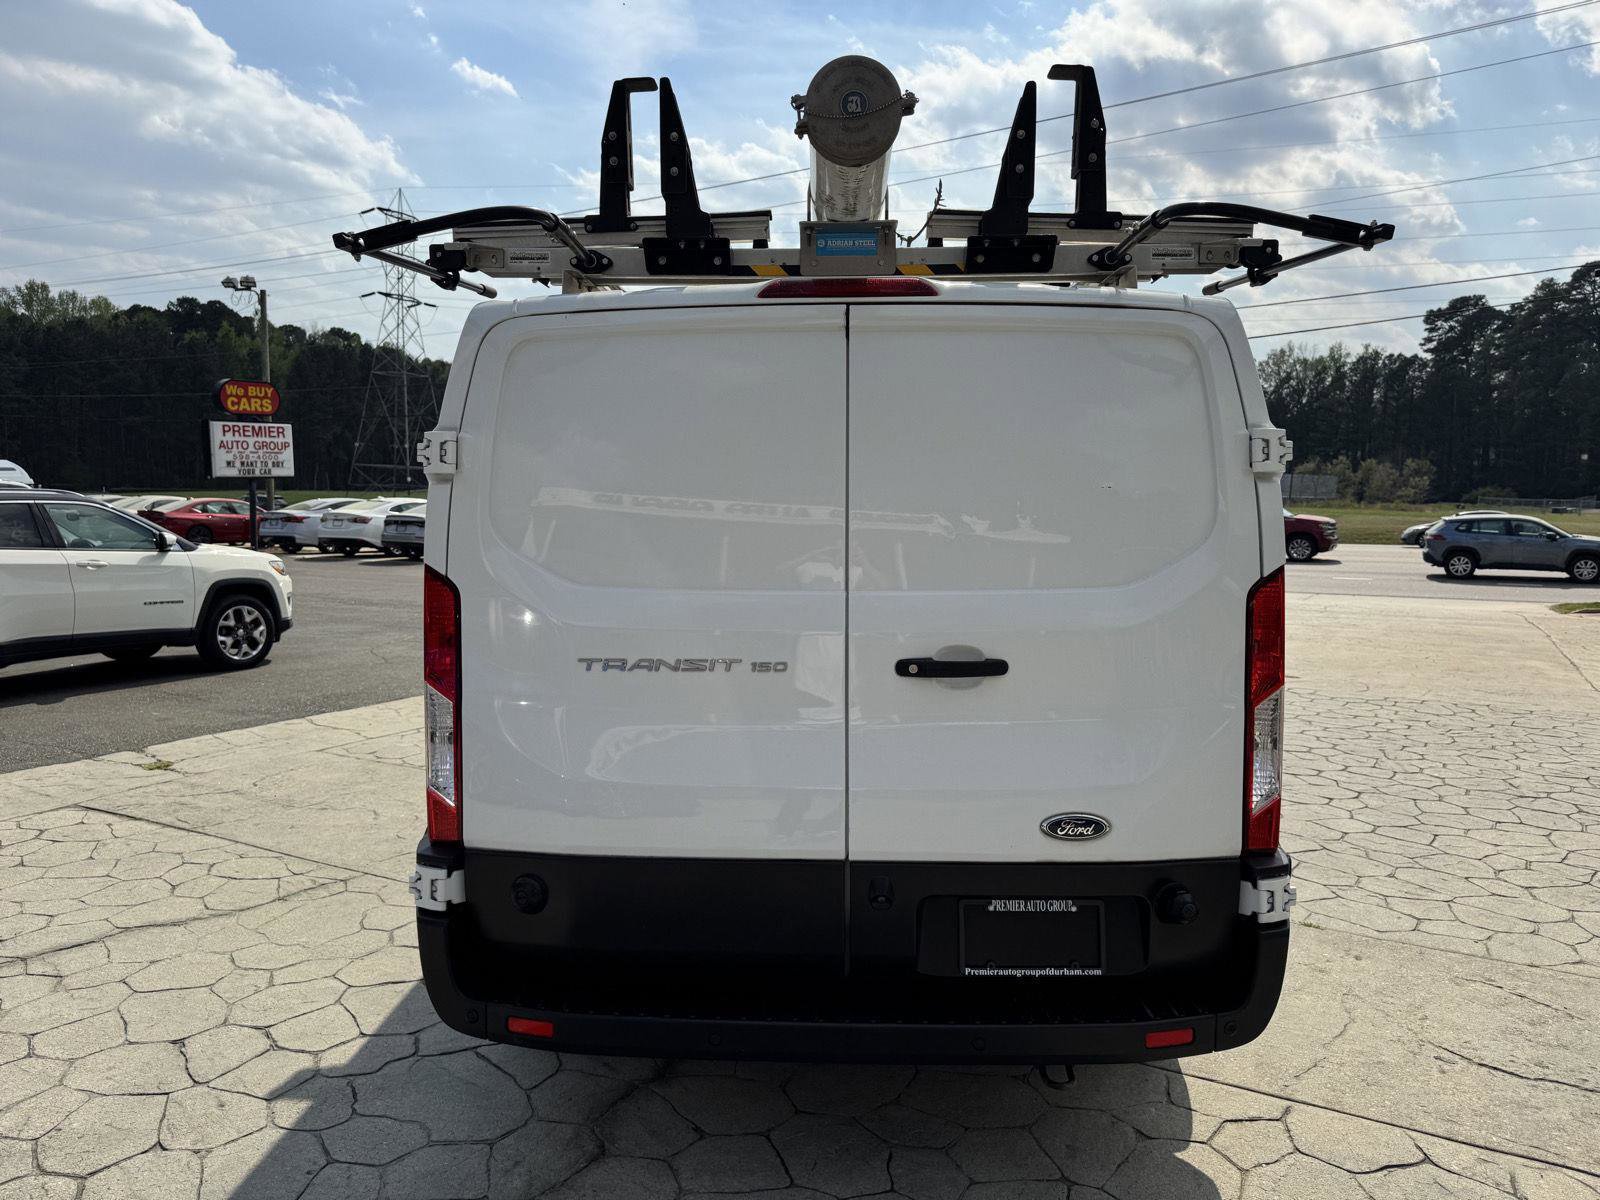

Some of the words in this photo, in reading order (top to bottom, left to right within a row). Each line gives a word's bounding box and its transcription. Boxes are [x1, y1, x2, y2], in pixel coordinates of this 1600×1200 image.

[827, 239, 853, 247] ADRIAN
[854, 239, 876, 247] STEEL
[225, 384, 244, 396] We
[248, 386, 274, 397] BUY
[226, 396, 273, 412] CARS
[222, 424, 286, 438] PREMIER
[218, 440, 249, 451] AUTO
[253, 441, 290, 451] GROUP
[226, 460, 236, 468] WE
[240, 460, 258, 468] WANT
[260, 460, 269, 468] TO
[577, 657, 743, 673] TRANSIT
[750, 661, 789, 673] 150
[1057, 819, 1096, 835] Ford
[991, 899, 1026, 912] PREMIER
[1026, 900, 1047, 912] AUTO
[1047, 900, 1073, 912] GROUP
[964, 967, 1102, 978] Premierautogroupofdurham.com
